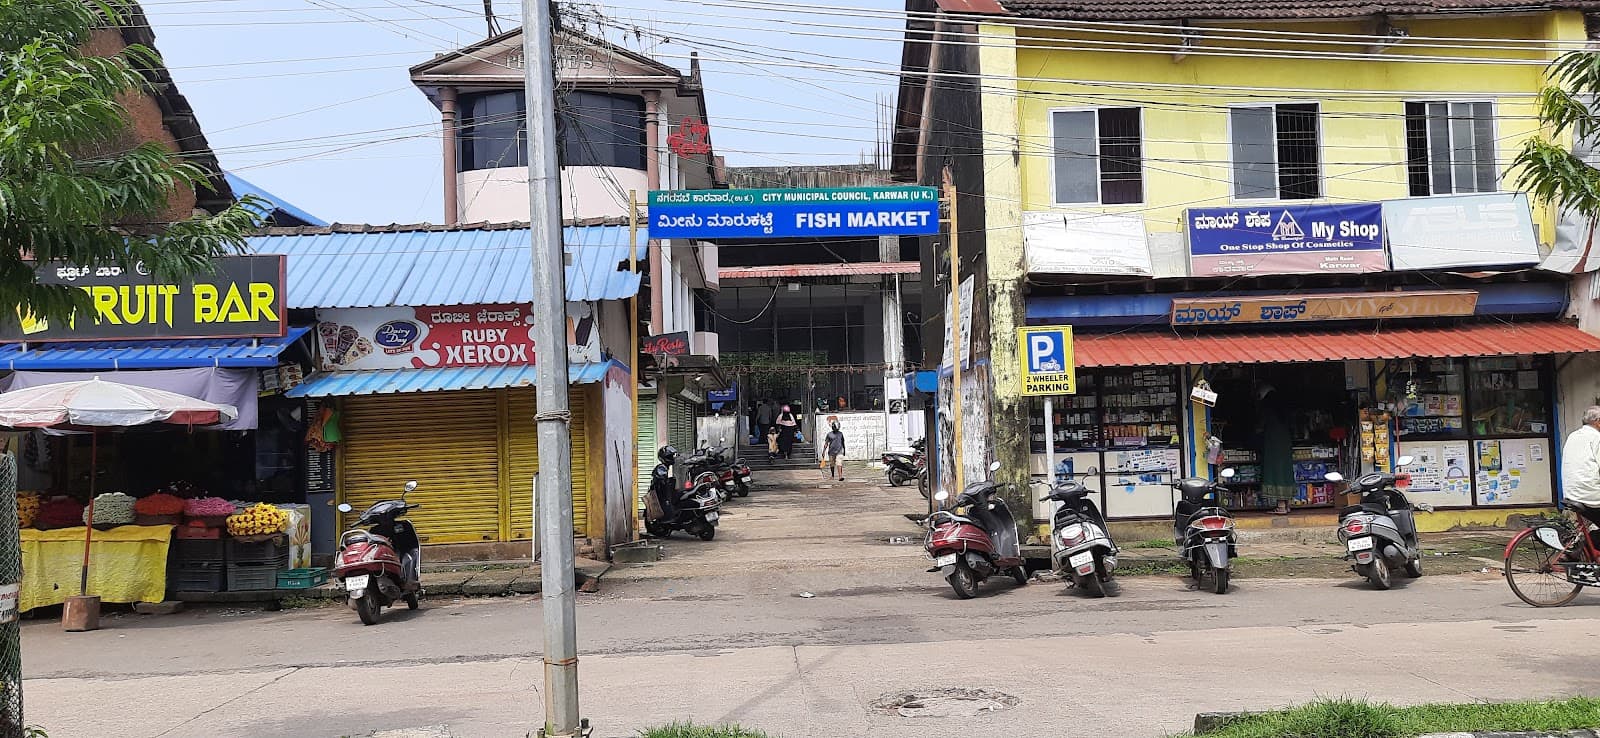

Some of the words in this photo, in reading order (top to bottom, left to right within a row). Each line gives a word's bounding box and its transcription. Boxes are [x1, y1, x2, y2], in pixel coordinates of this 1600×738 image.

[762, 193, 783, 202] CITY
[784, 192, 829, 202] MUNICIPAL
[832, 191, 871, 202] COUNCIL,
[873, 191, 909, 201] KARWAR
[658, 213, 703, 228] ಮೀನು
[706, 211, 774, 234] ಮಾರುಕಟ್ಟೆ
[796, 212, 841, 228] FISH
[848, 211, 931, 228] MARKET
[1194, 211, 1239, 229] ಮಾಯ್
[1312, 221, 1334, 240] My
[1340, 221, 1379, 240] Shop
[193, 281, 279, 323] BAR
[1175, 303, 1241, 322] ಮಾಯ್
[1259, 301, 1307, 320] ಶಾಪ್
[381, 324, 410, 337] Dairy
[386, 333, 407, 346] Day
[462, 328, 509, 343] RUBY
[446, 344, 529, 364] XEROX
[1031, 335, 1054, 370] P
[1026, 383, 1069, 393] PARKING
